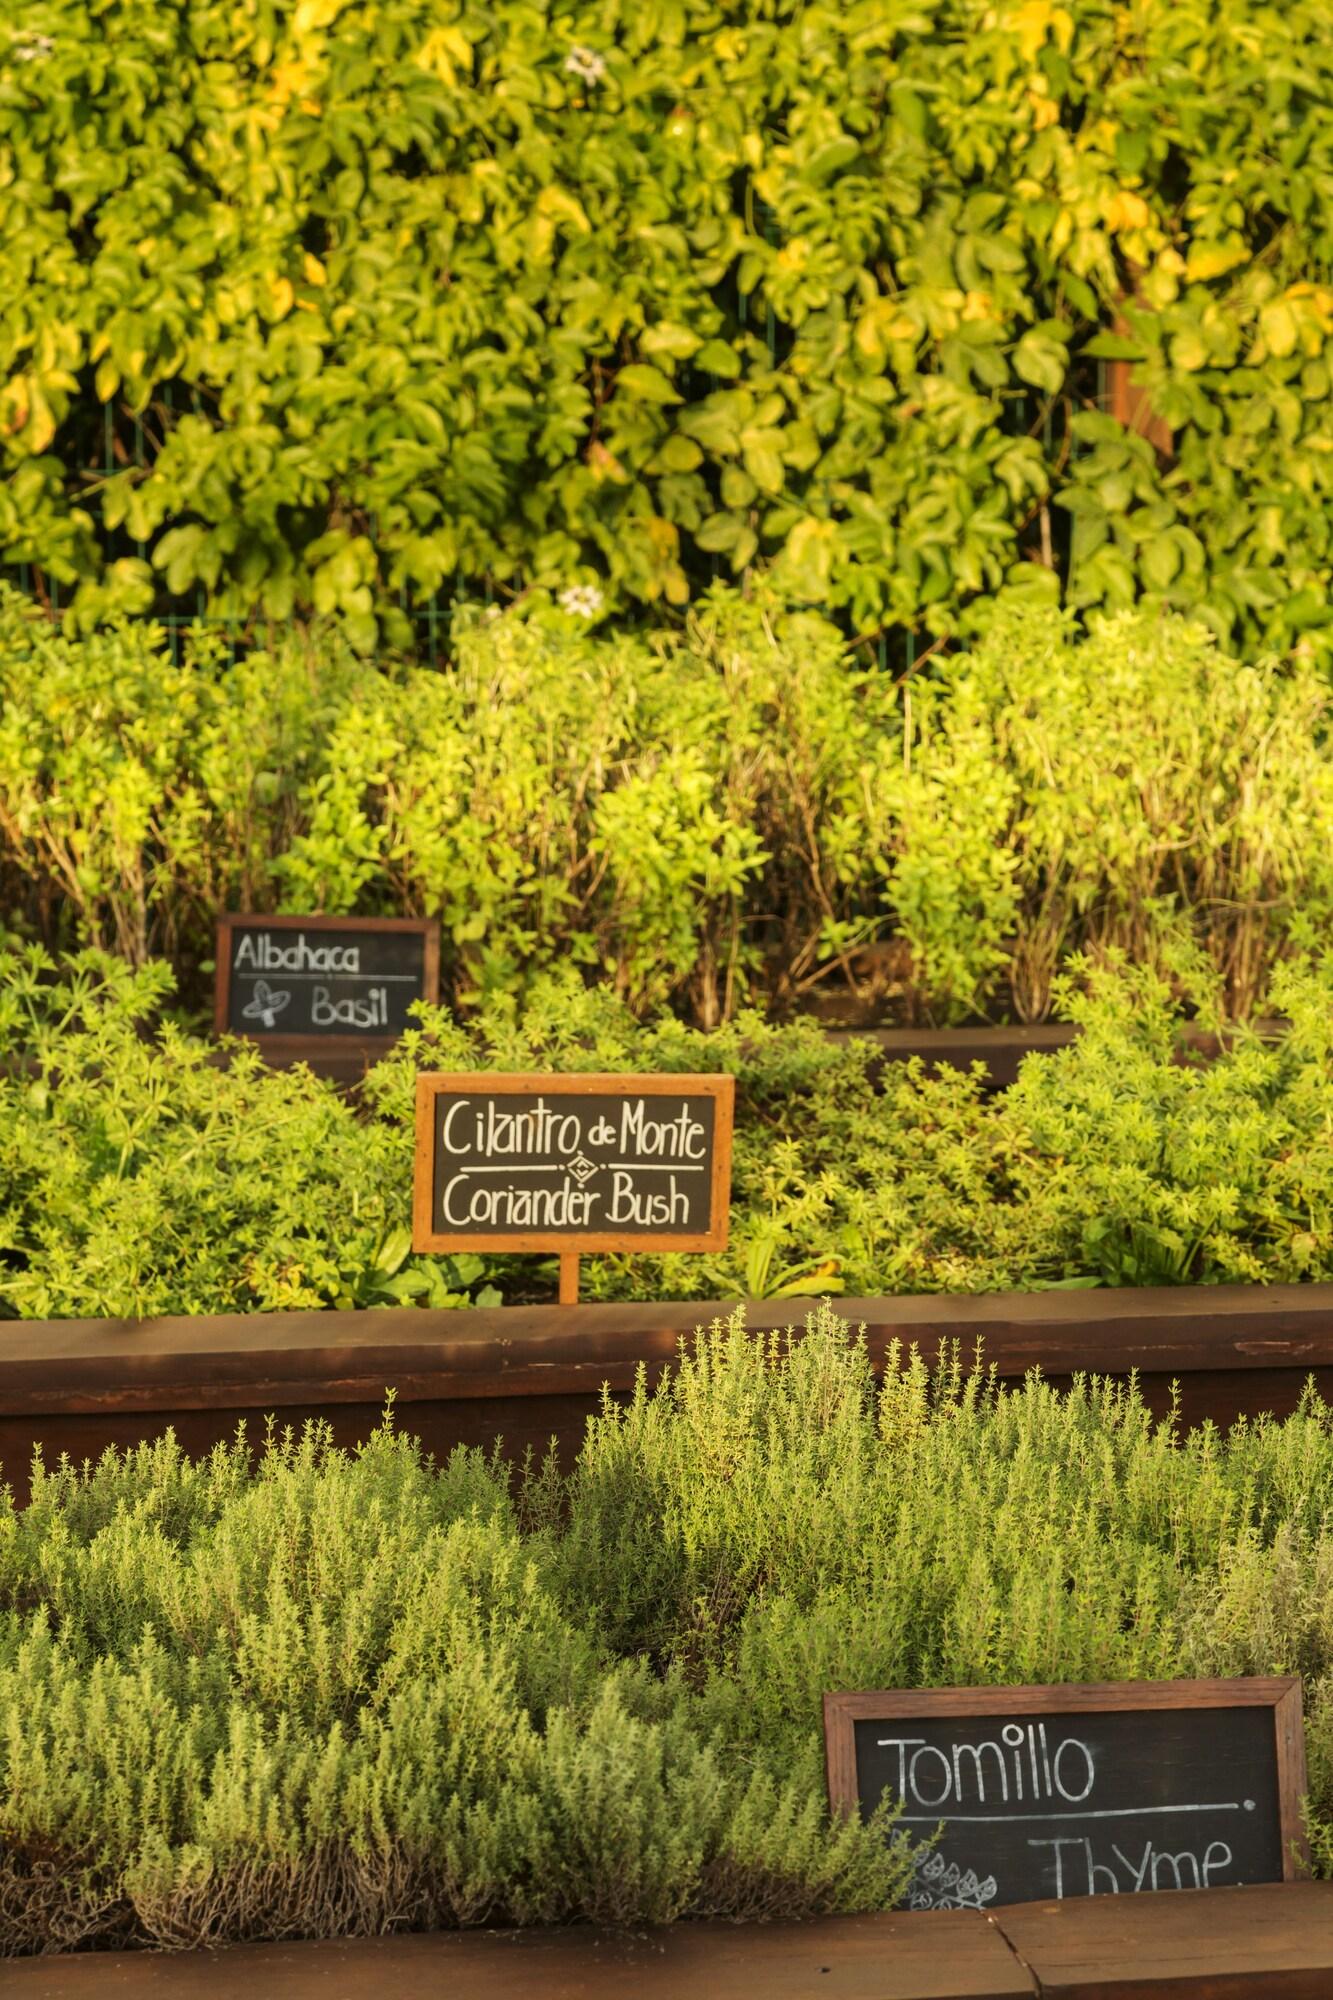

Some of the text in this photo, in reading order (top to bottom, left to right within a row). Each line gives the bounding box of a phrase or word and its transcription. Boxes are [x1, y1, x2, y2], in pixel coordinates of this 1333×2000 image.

[234, 932, 360, 973] Albahaca
[311, 985, 388, 1028] Basil
[443, 1097, 706, 1159] Cilantro de Monte
[442, 1171, 690, 1226] Coriander Bush
[877, 1722, 1095, 1806] Tomillo
